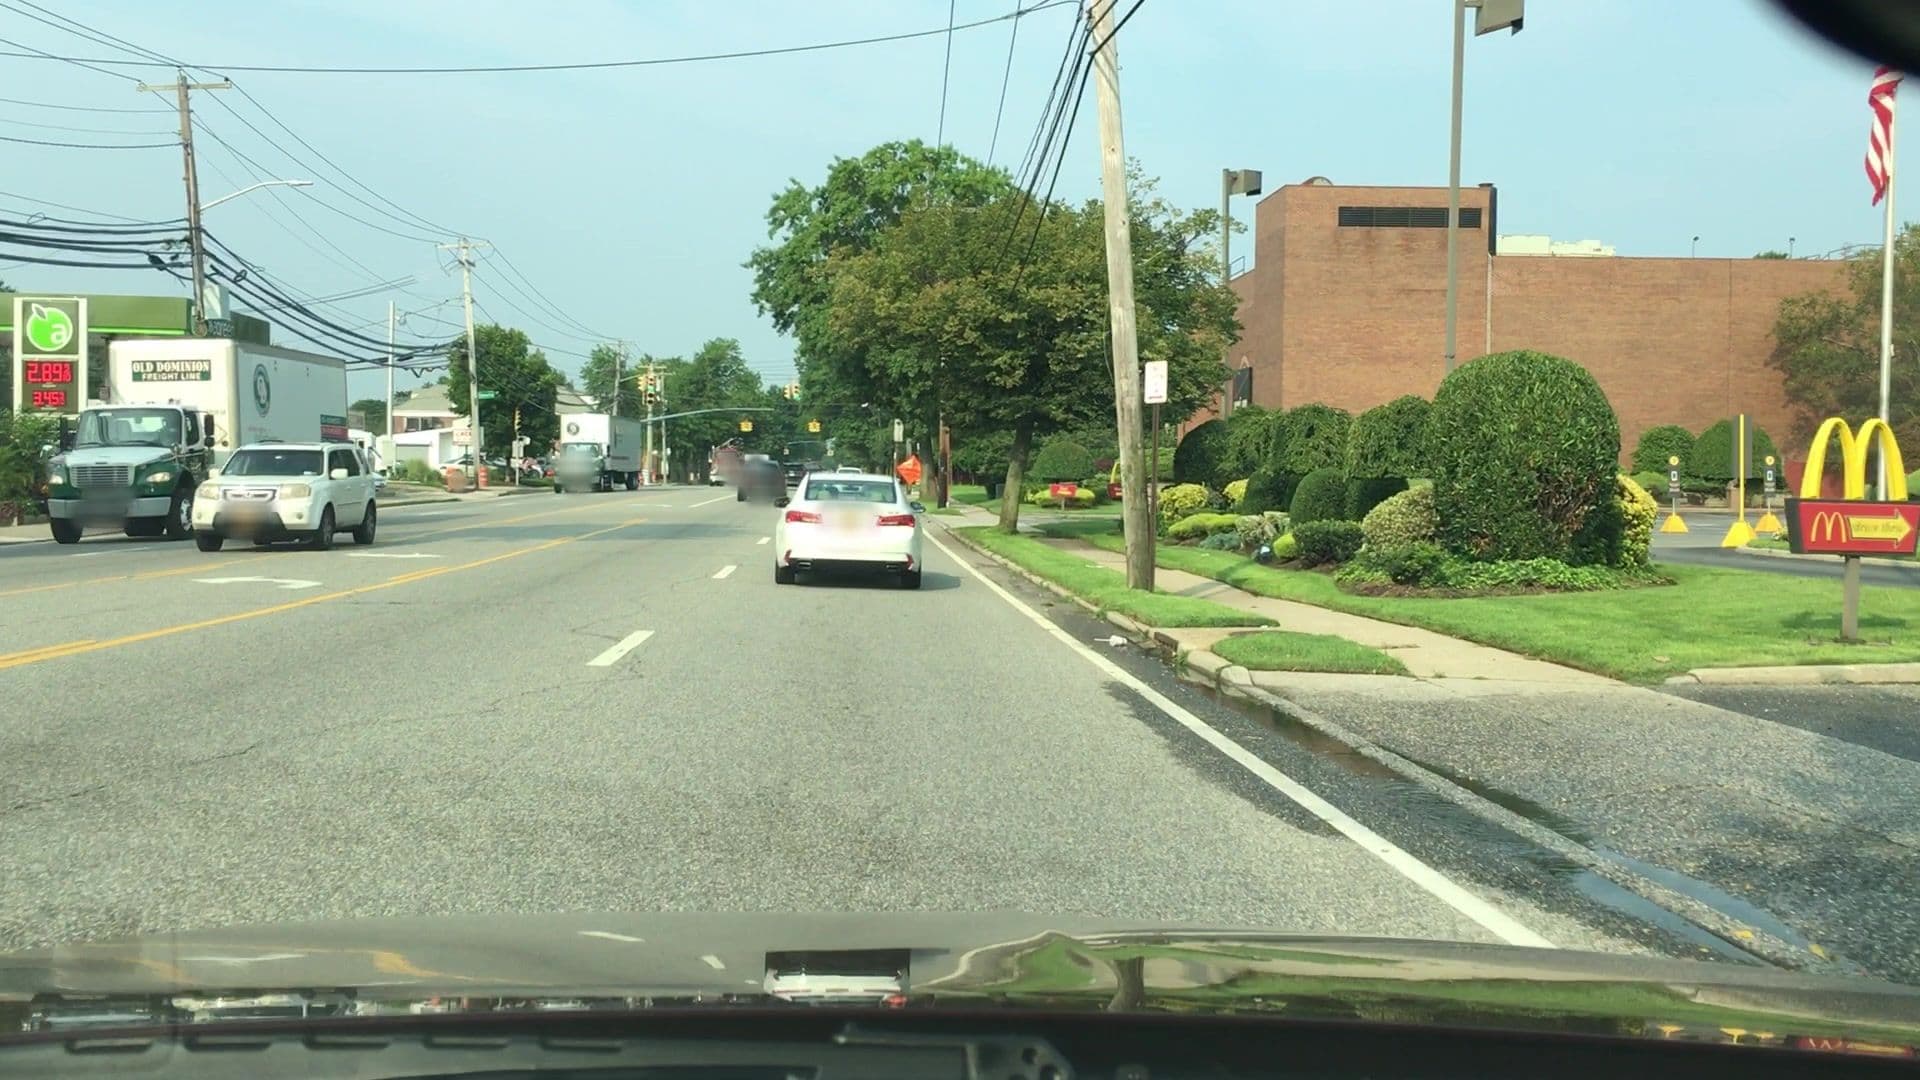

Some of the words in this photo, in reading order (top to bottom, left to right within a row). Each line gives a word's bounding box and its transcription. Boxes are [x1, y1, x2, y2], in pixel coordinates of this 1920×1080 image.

[133, 361, 154, 373] OLD
[156, 360, 209, 373] DOMINION
[142, 372, 178, 381] FREIGHT
[180, 372, 201, 381] LINE
